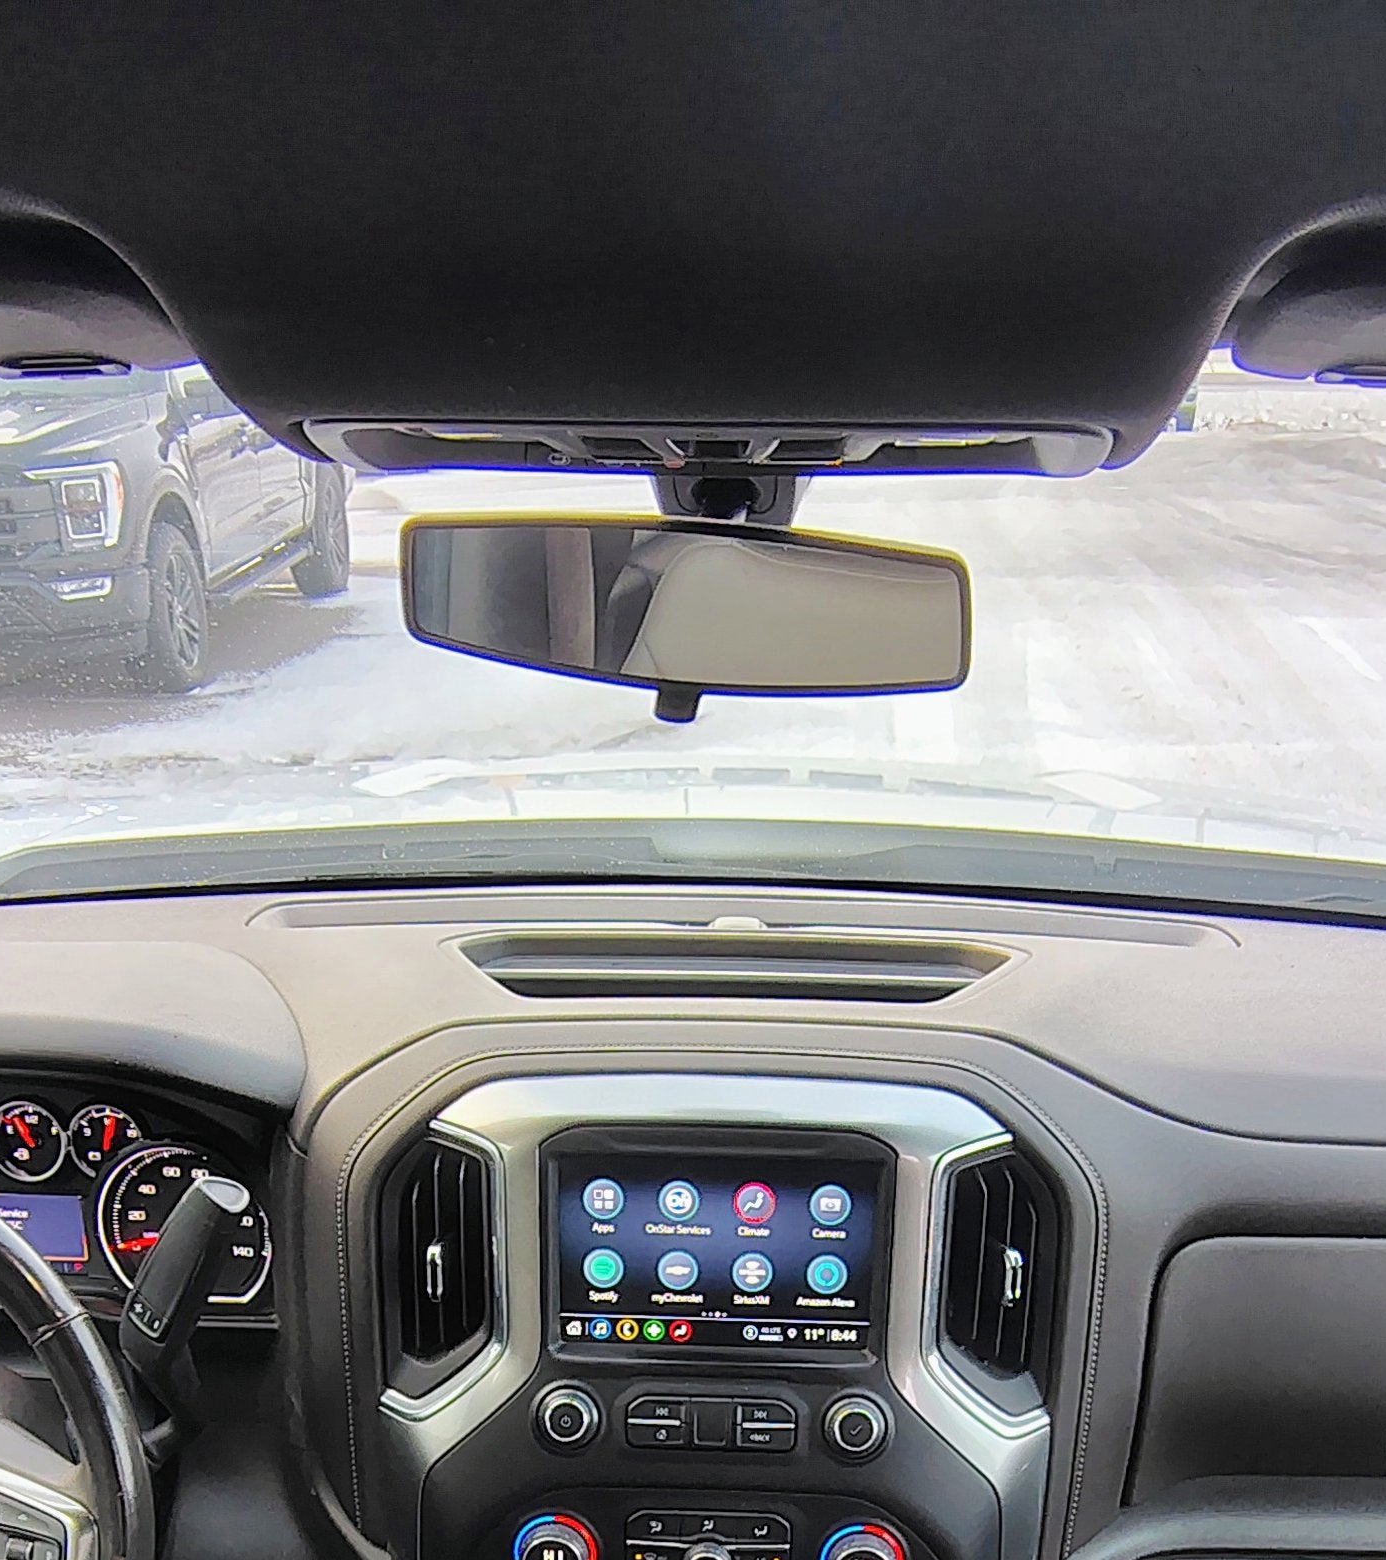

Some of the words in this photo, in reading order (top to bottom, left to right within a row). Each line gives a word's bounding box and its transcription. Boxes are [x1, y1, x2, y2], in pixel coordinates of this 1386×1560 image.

[163, 1167, 180, 1177] 60
[191, 1169, 209, 1178] 80
[138, 1184, 156, 1195] 40
[128, 1210, 146, 1221] 20
[591, 1222, 615, 1234] Apps
[645, 1223, 675, 1234] OnStar
[676, 1224, 712, 1235] Services
[737, 1226, 770, 1237] Climate
[812, 1227, 847, 1239] Camera
[232, 1246, 254, 1257] 140
[588, 1290, 619, 1304] Spotify
[733, 1294, 770, 1305] SiriusXM
[796, 1296, 830, 1307] Amazon
[831, 1297, 855, 1308] Alexa
[831, 1328, 858, 1342] 8:44
